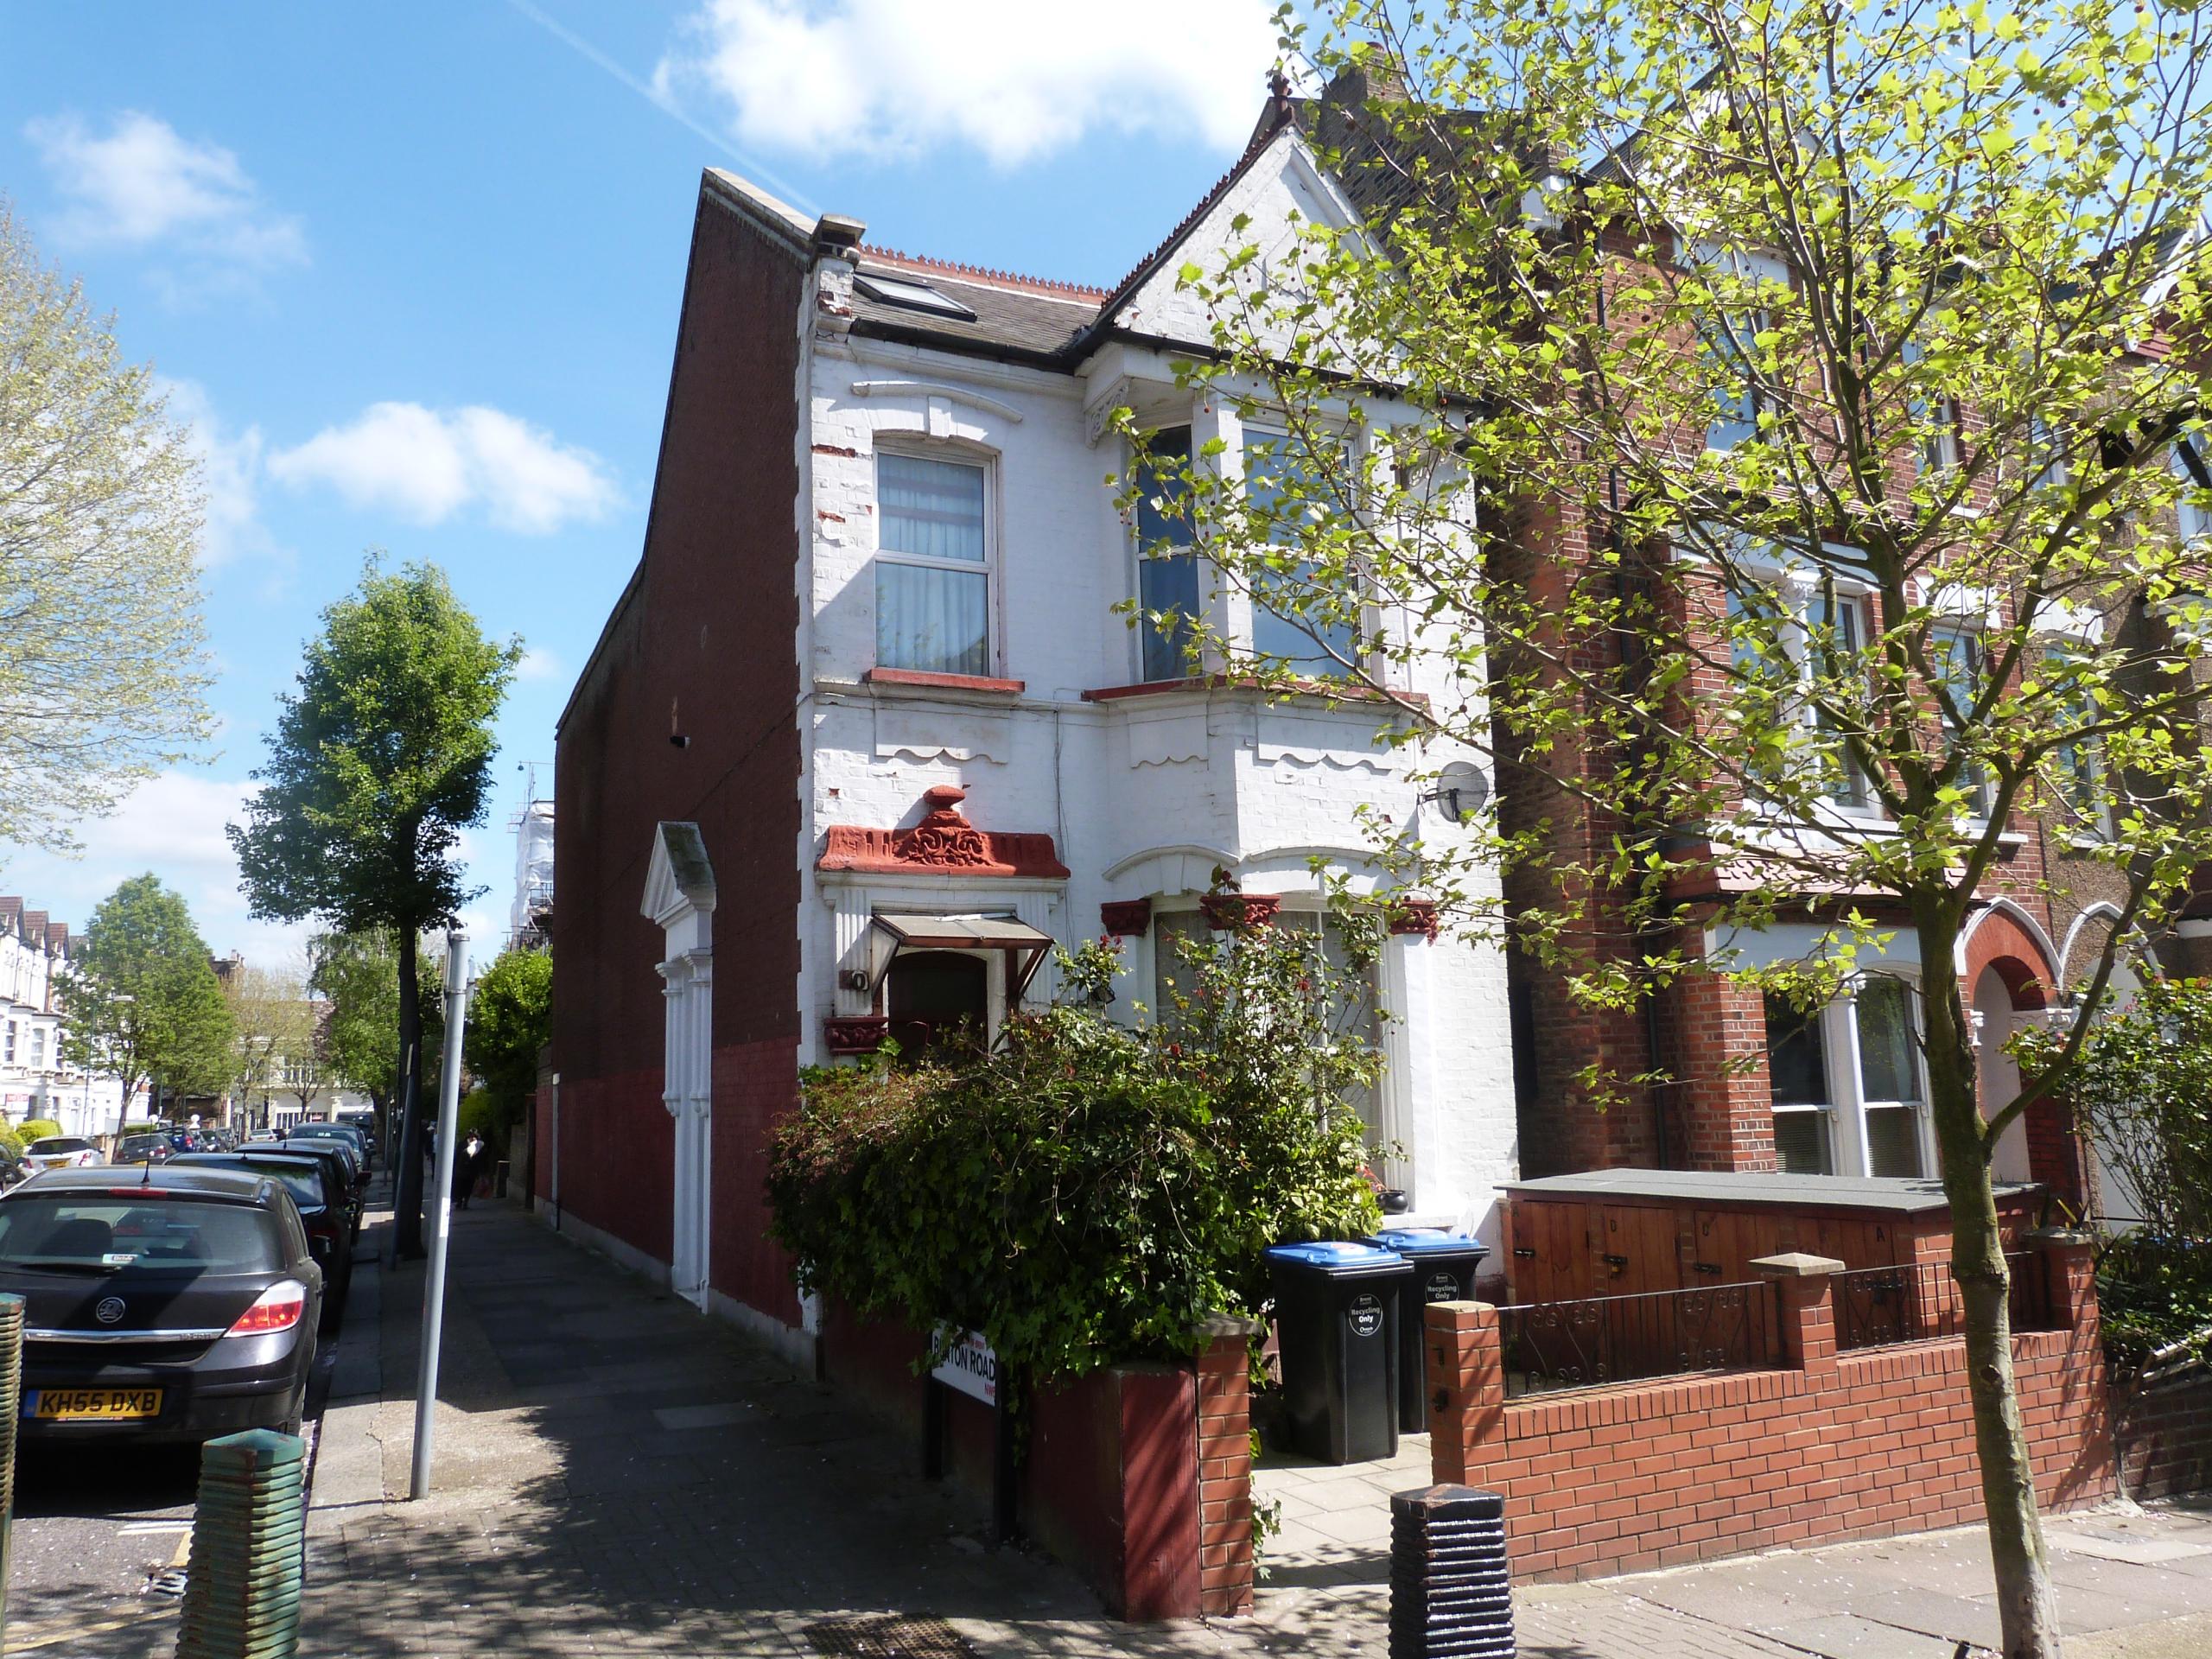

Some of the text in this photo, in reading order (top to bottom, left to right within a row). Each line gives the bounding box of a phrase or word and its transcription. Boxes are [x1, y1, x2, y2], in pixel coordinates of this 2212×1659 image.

[1876, 1226, 1886, 1243] A
[1351, 1306, 1380, 1315] Recycling
[1358, 1314, 1373, 1323] Only
[934, 1336, 996, 1381] BTON ROAD
[40, 1391, 157, 1413] KH55 DXB
